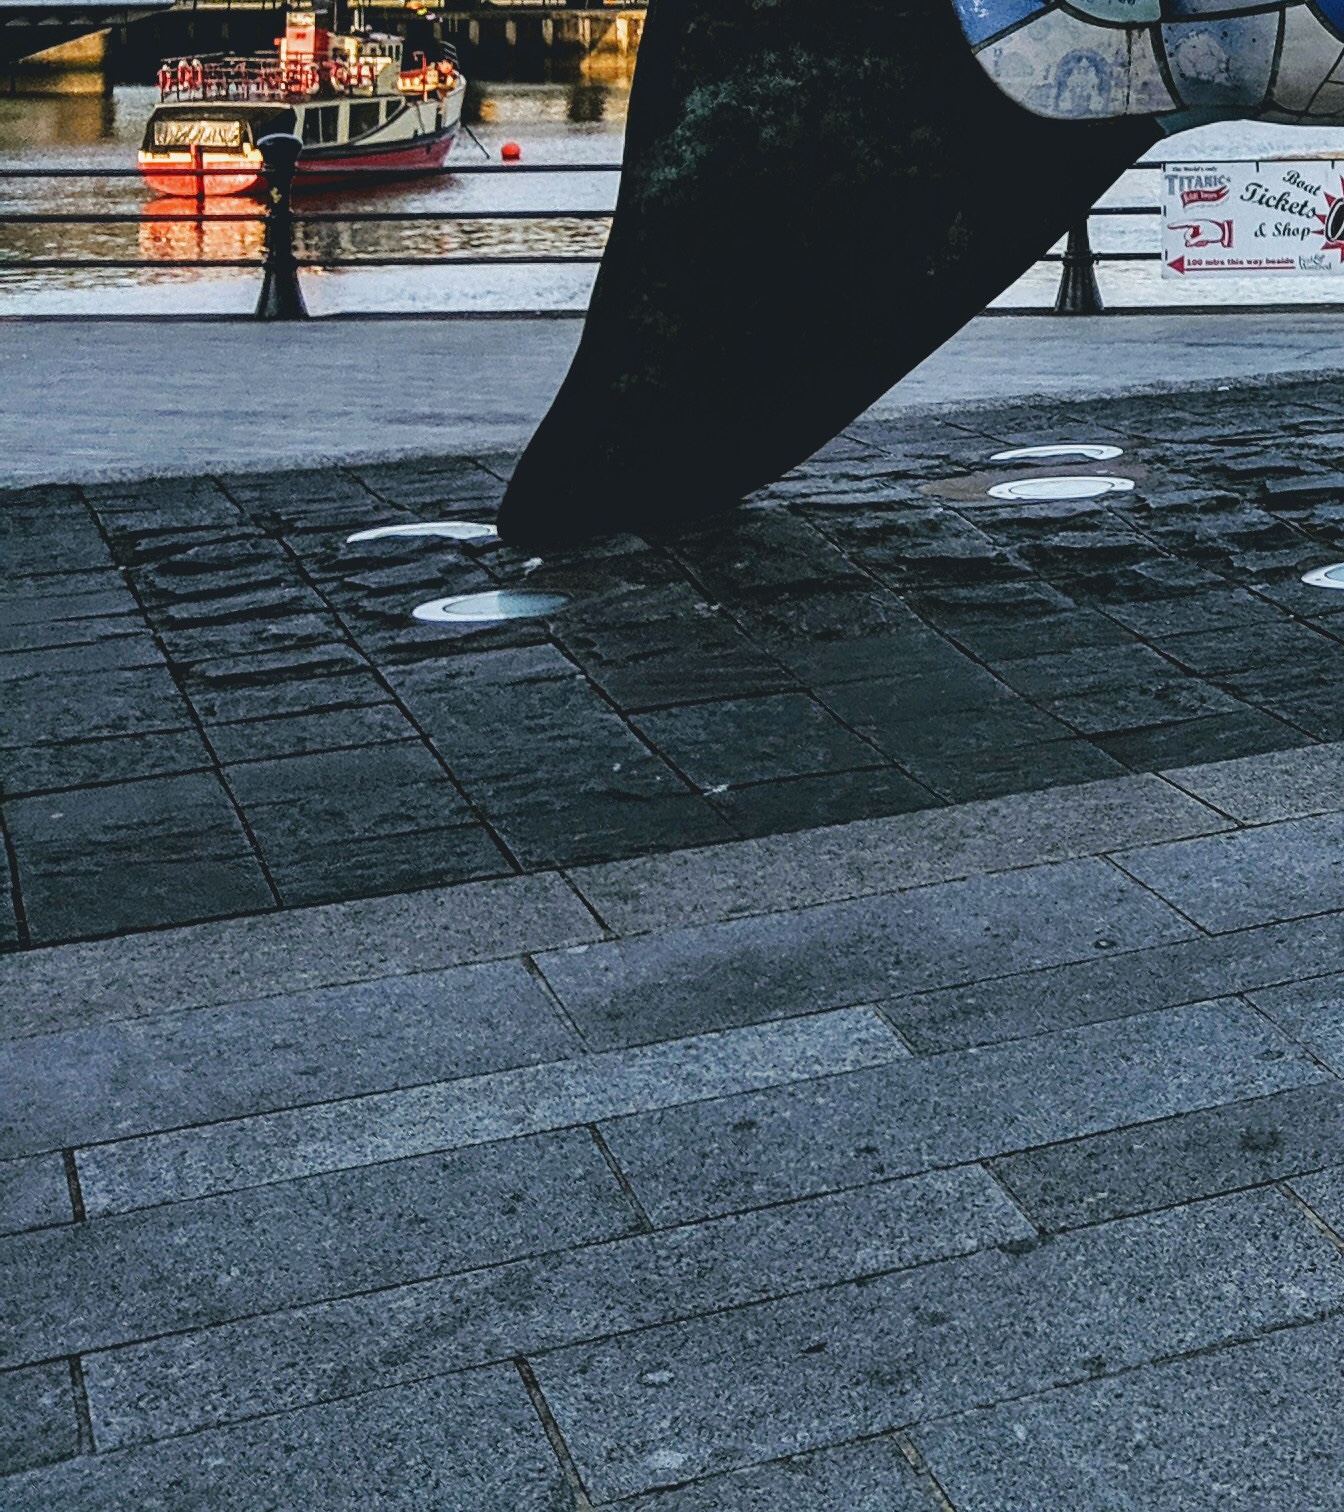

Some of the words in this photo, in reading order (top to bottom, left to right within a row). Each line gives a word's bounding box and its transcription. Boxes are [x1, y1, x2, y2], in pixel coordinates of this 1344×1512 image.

[1282, 169, 1322, 197] Boat
[1239, 182, 1317, 219] Tickets
[1254, 222, 1267, 238] &
[1272, 221, 1311, 241] Shop
[1186, 258, 1203, 266] 100
[1227, 257, 1244, 265] this
[1246, 258, 1263, 267] way
[1265, 257, 1295, 265] beside
